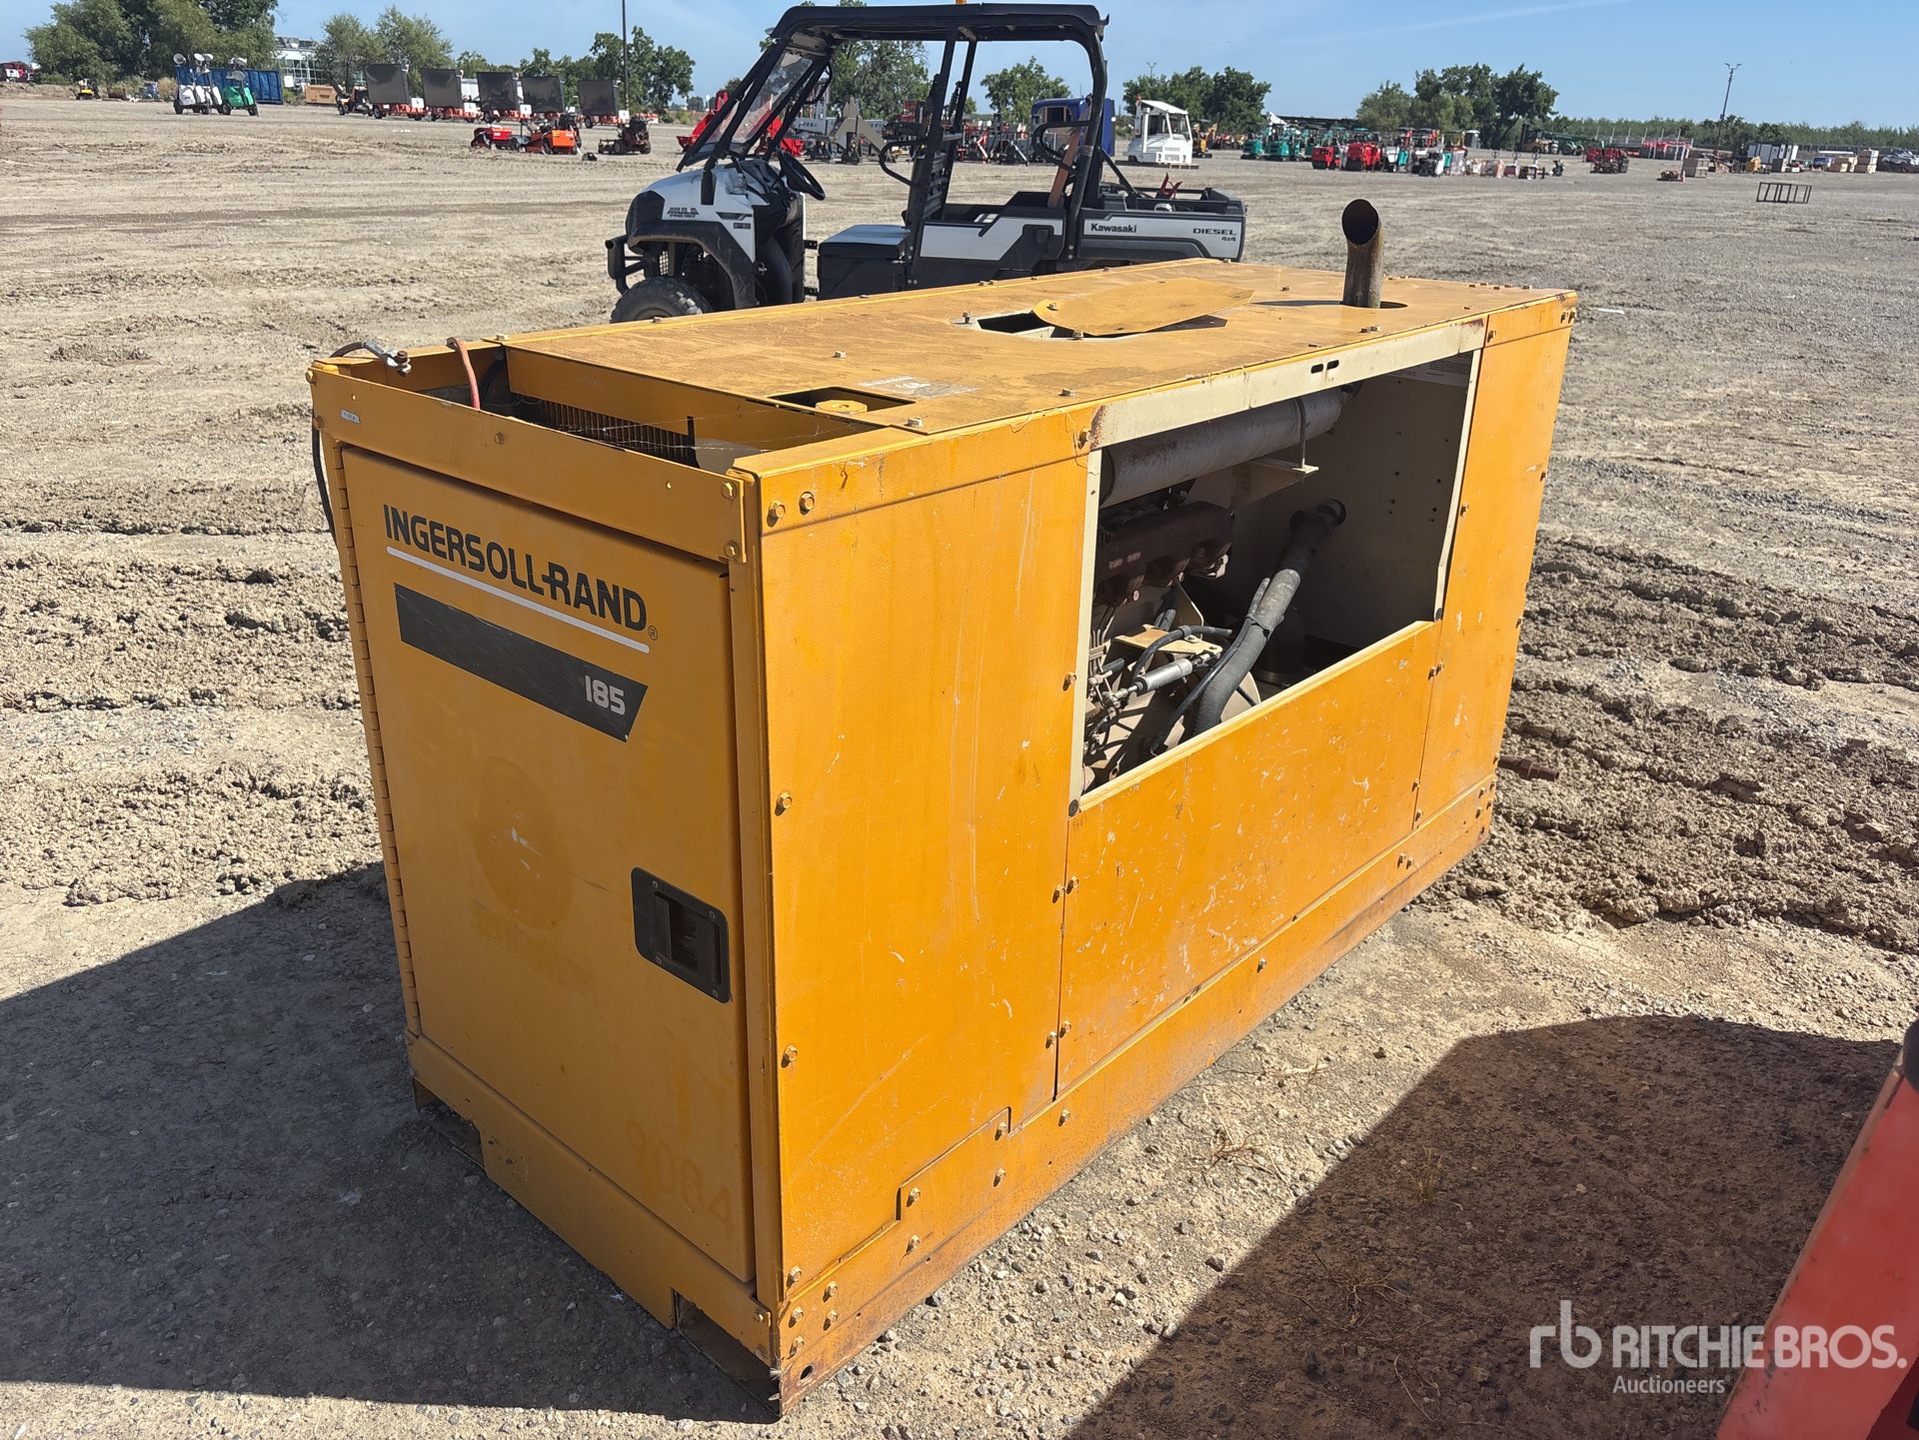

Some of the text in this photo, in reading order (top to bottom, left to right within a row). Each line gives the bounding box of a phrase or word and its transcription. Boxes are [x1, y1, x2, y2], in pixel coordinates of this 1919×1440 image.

[1091, 222, 1137, 233] Kawasaki
[1192, 227, 1237, 236] DIESEL
[584, 675, 626, 715] 185
